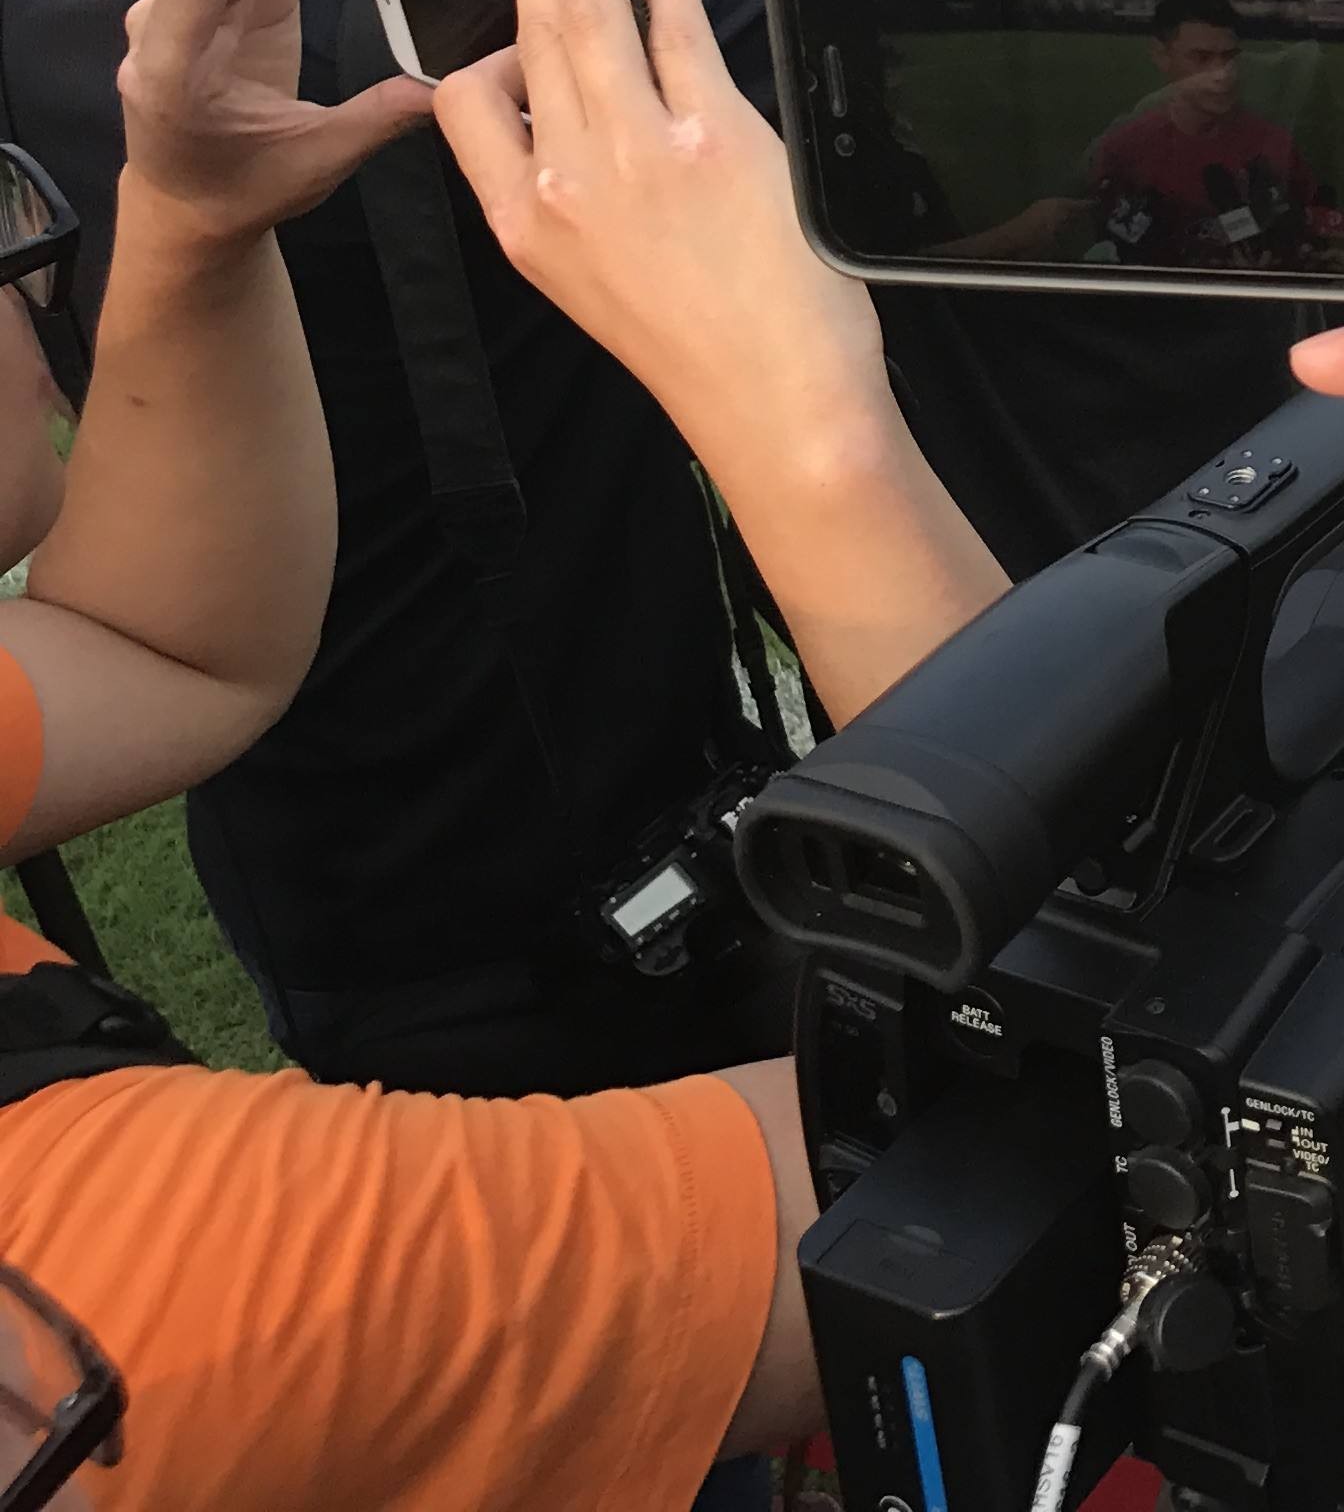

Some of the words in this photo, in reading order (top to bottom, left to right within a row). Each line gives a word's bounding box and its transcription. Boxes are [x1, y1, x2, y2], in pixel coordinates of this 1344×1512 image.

[962, 1004, 990, 1021] BATT
[951, 1011, 1003, 1037] RELEASE
[1101, 1036, 1123, 1128] GENLOCK/VIDEO
[1245, 1097, 1315, 1122] GENLOCK/TC
[1301, 1126, 1314, 1139] IN
[1301, 1138, 1329, 1153] OUT
[1115, 1155, 1129, 1173] TC
[1123, 1222, 1138, 1252] OUT
